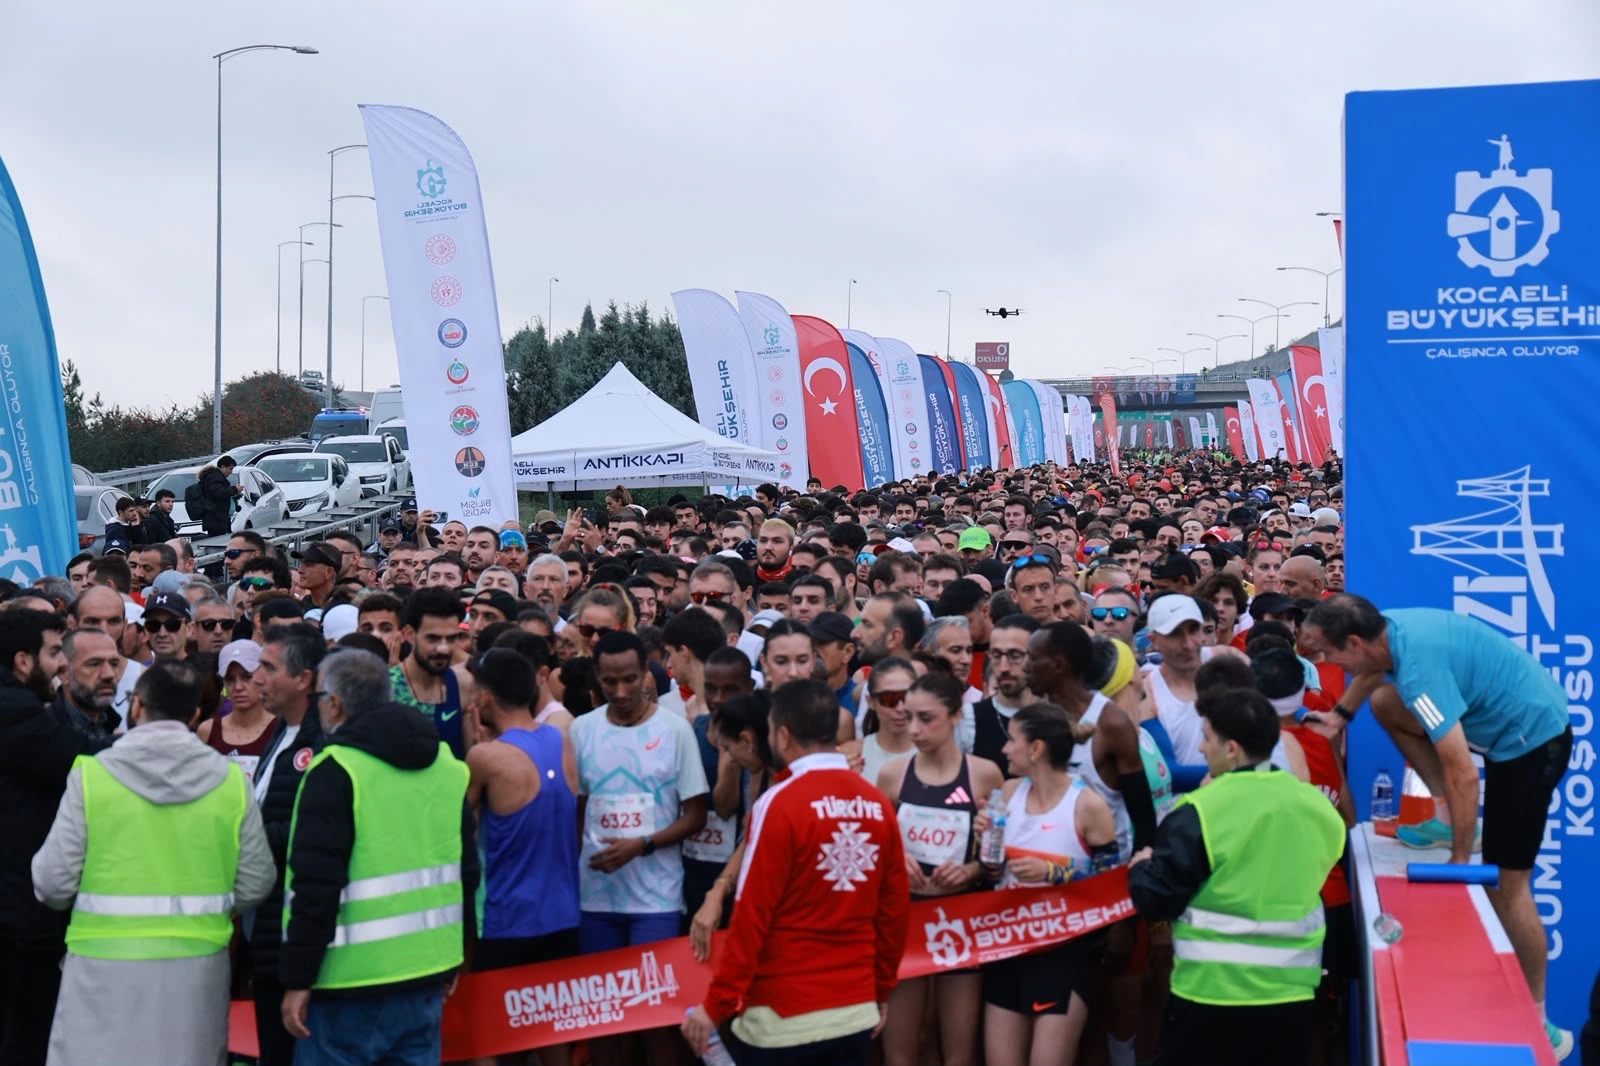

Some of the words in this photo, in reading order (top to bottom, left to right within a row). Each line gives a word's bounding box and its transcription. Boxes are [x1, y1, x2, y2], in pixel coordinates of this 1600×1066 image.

[1426, 347, 1508, 360] ÇALIŞINCA
[1512, 345, 1580, 357] OLUYOR
[0, 343, 21, 414] OLUYOR
[15, 418, 39, 506] ÇALIŞINCA
[515, 466, 566, 476] ÜKŞEHİR
[583, 453, 684, 470] ANTİKKAPI
[1564, 633, 1598, 837] KOŞUSU
[600, 811, 643, 829] 6323
[810, 795, 884, 821] TÜRKİYE
[907, 825, 958, 847] 6407
[969, 898, 1068, 931] KOCAELİ
[509, 998, 623, 1028] CUMHURİYET
[554, 1009, 625, 1032] KOŞUSU
